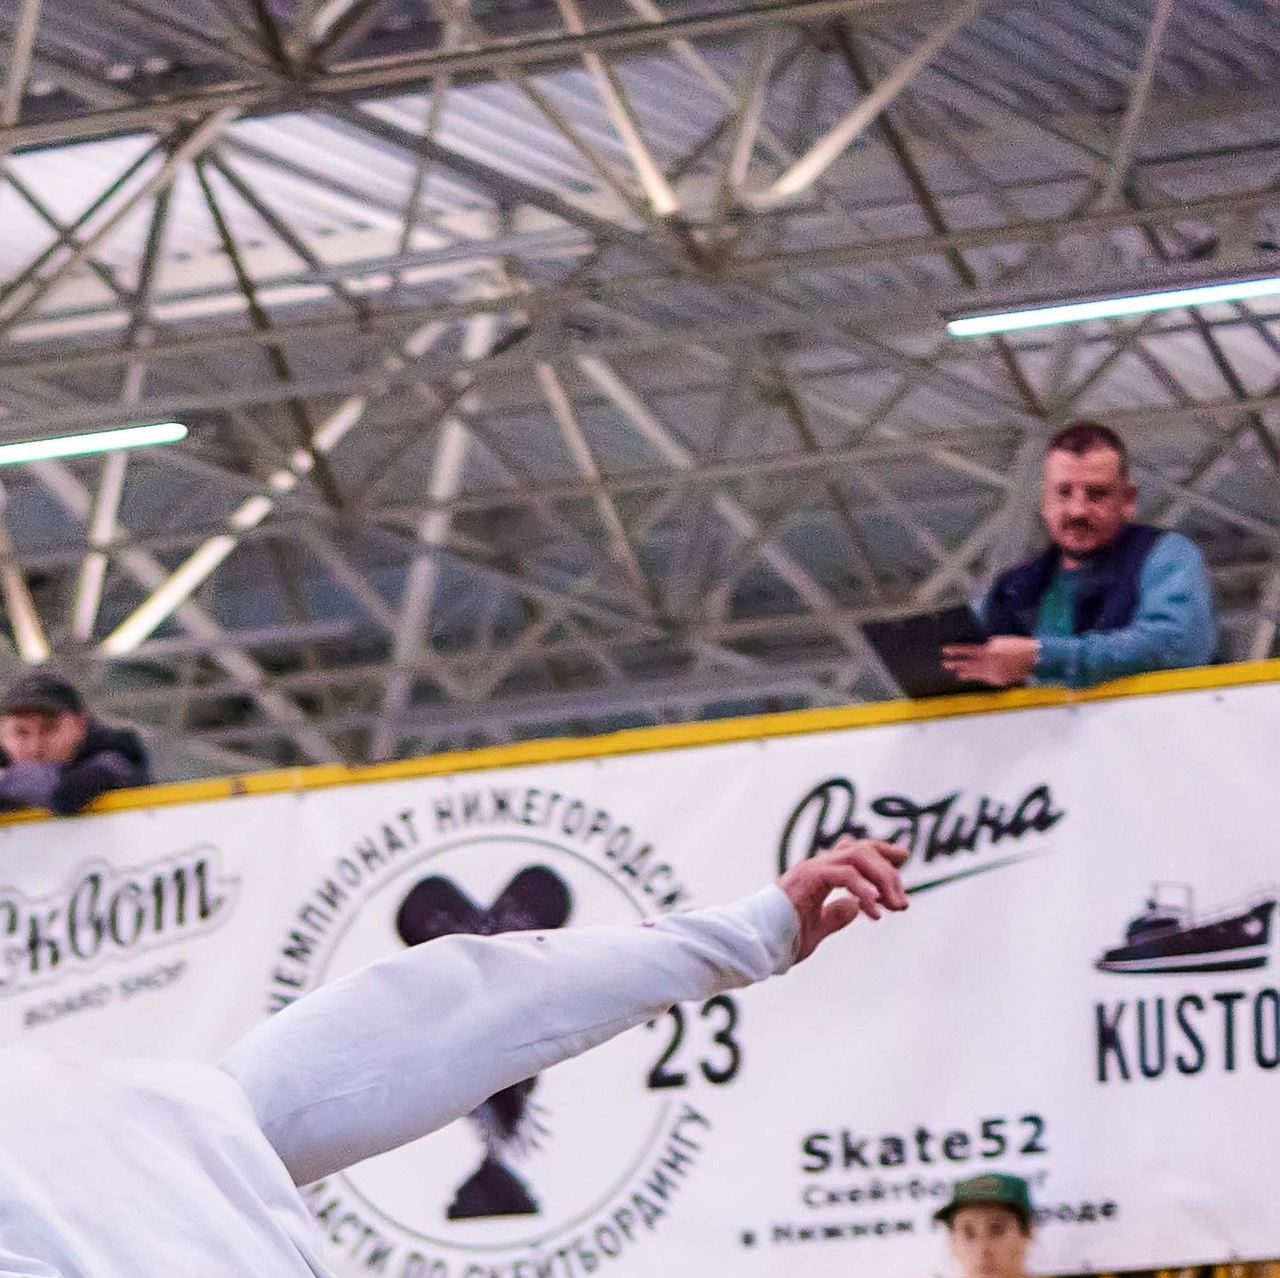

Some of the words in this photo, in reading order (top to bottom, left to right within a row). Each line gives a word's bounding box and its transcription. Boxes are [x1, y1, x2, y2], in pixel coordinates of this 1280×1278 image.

[432, 786, 690, 913] НИЖЕГОРОДСК
[646, 994, 742, 1089] 23
[801, 1113, 1048, 1172] Skate52
